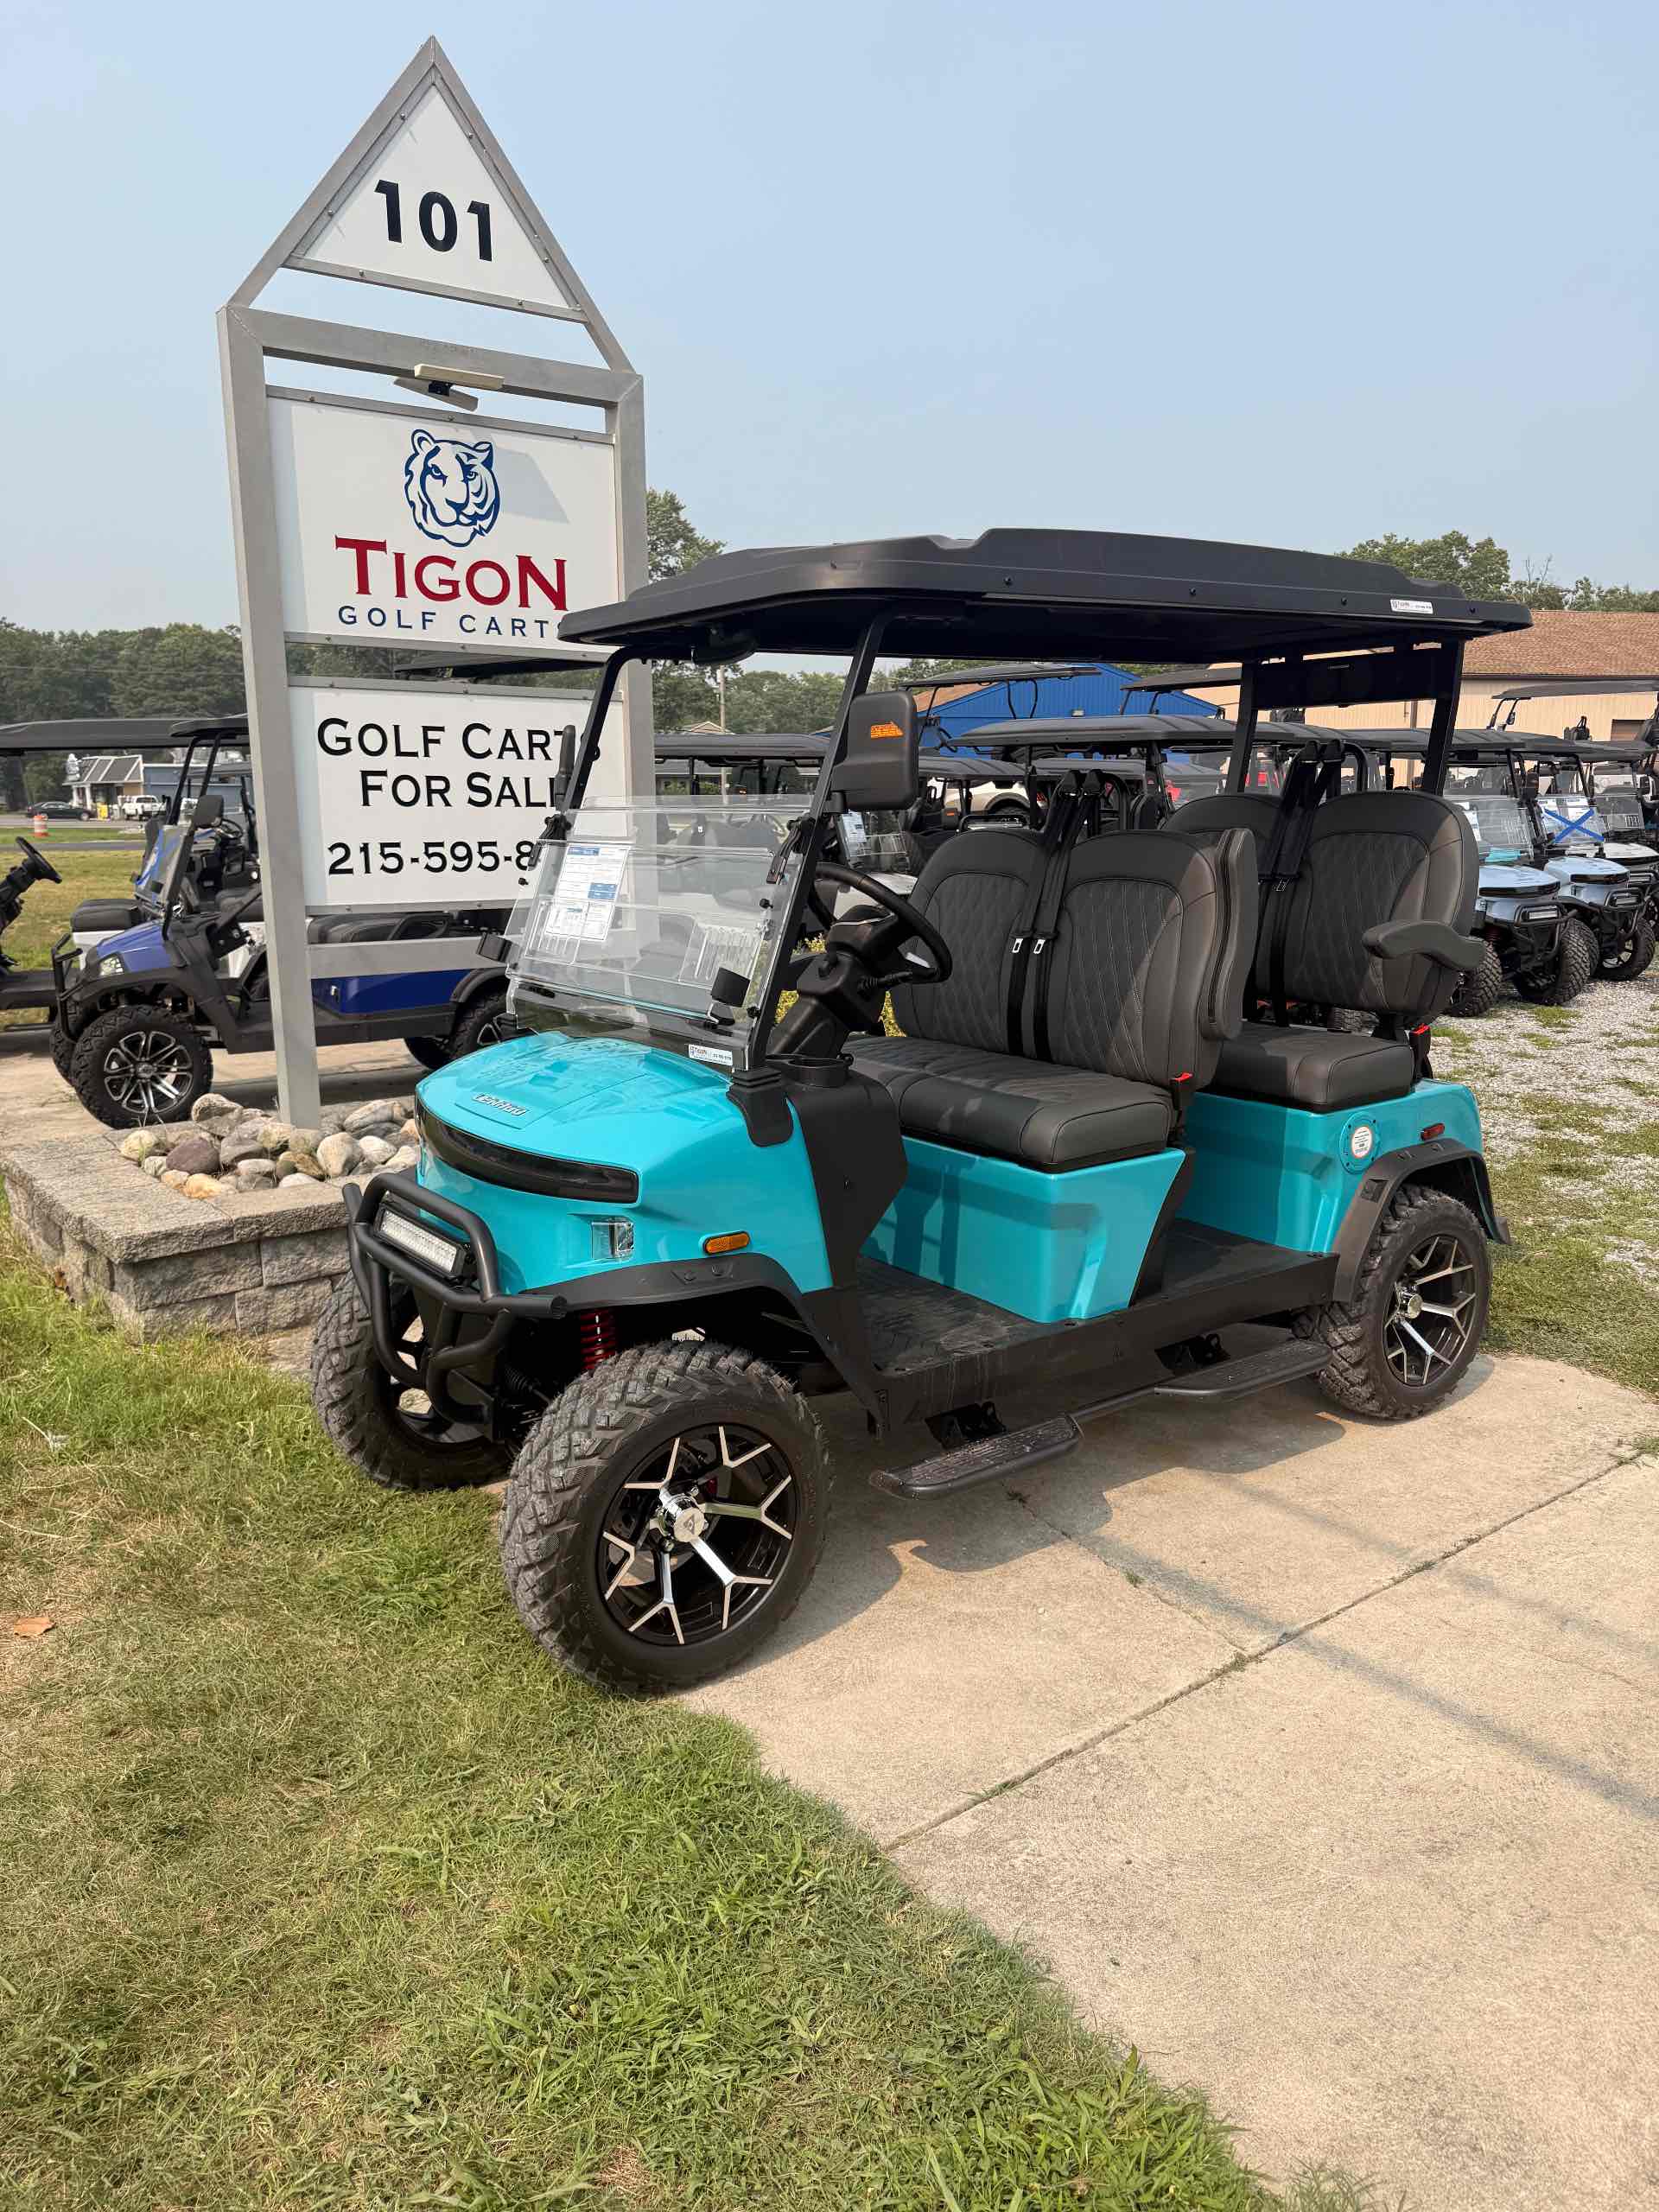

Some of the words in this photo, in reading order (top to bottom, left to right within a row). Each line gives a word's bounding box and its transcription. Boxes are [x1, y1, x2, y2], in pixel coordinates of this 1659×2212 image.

[374, 179, 493, 262] 101
[334, 536, 569, 611] TIGON
[338, 606, 436, 630] GOLF
[460, 614, 560, 638] CART
[317, 718, 445, 758] GOLF
[359, 769, 452, 807] FOR
[327, 841, 534, 874] 215-595-8
